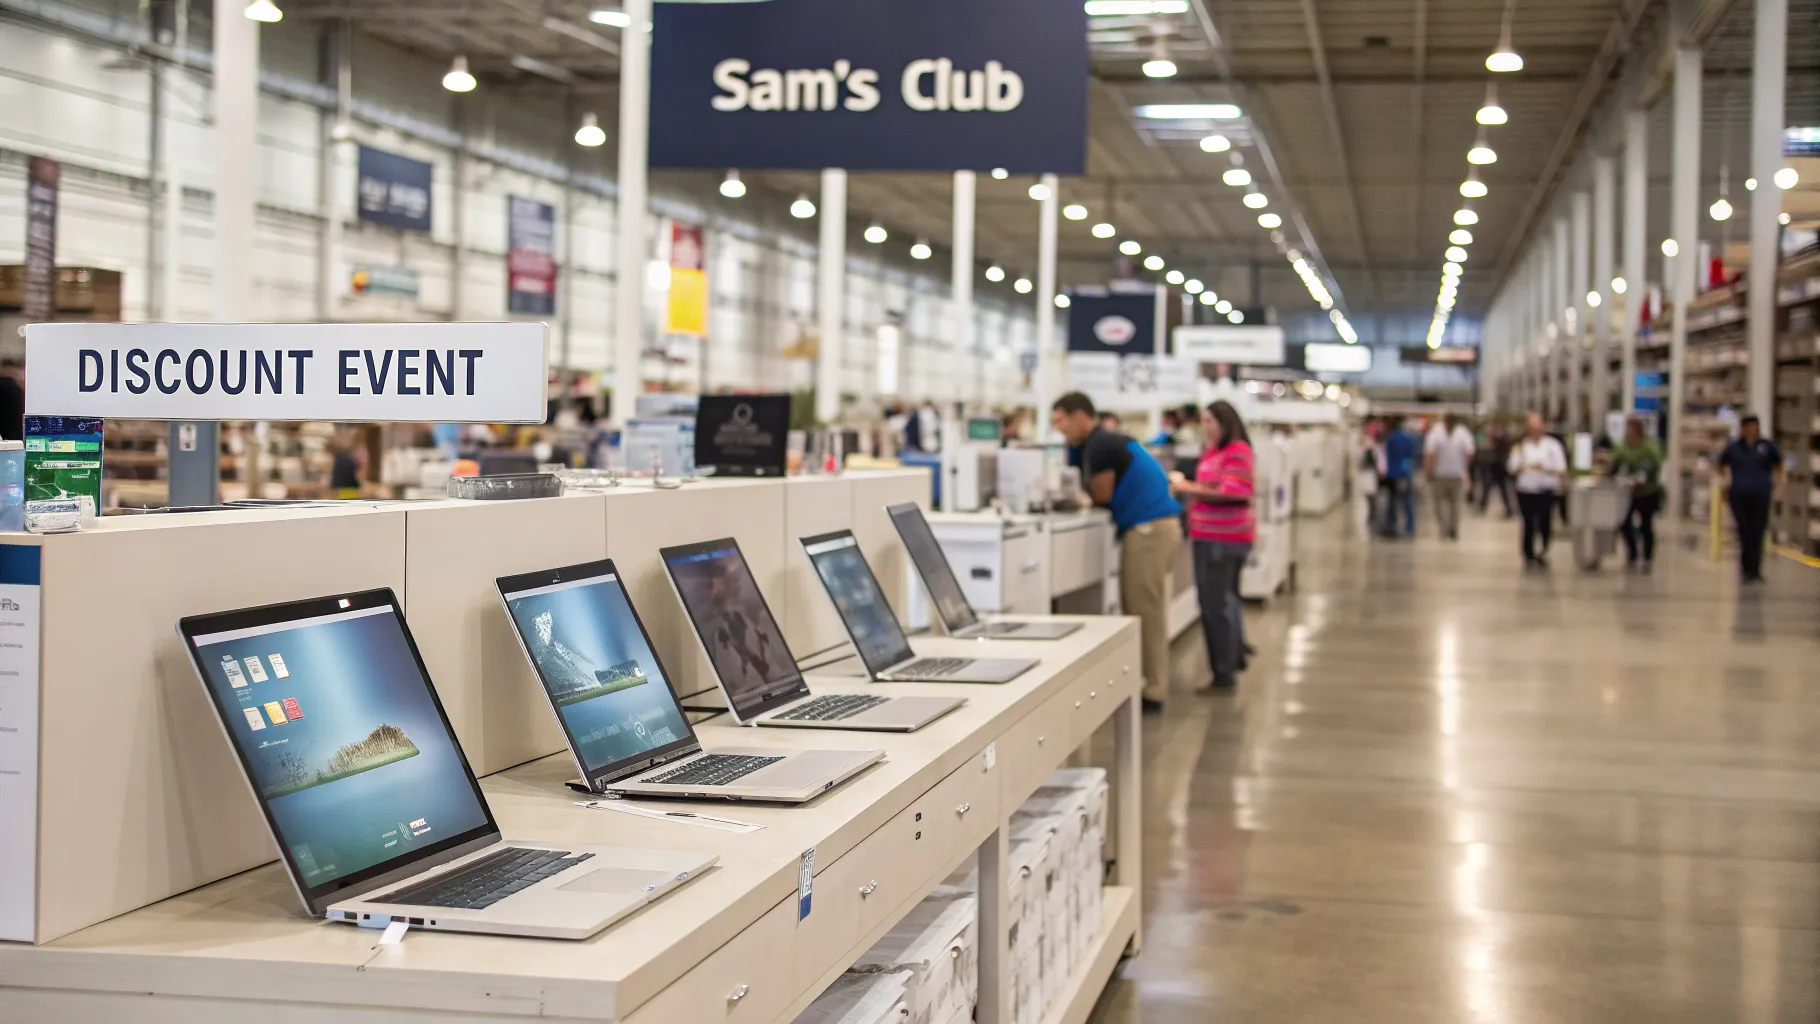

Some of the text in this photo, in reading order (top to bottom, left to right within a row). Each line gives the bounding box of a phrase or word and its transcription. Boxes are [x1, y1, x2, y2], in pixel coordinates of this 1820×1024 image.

[711, 57, 1024, 112] Sam's Club
[78, 348, 484, 396] DISCOUNT EVENT
